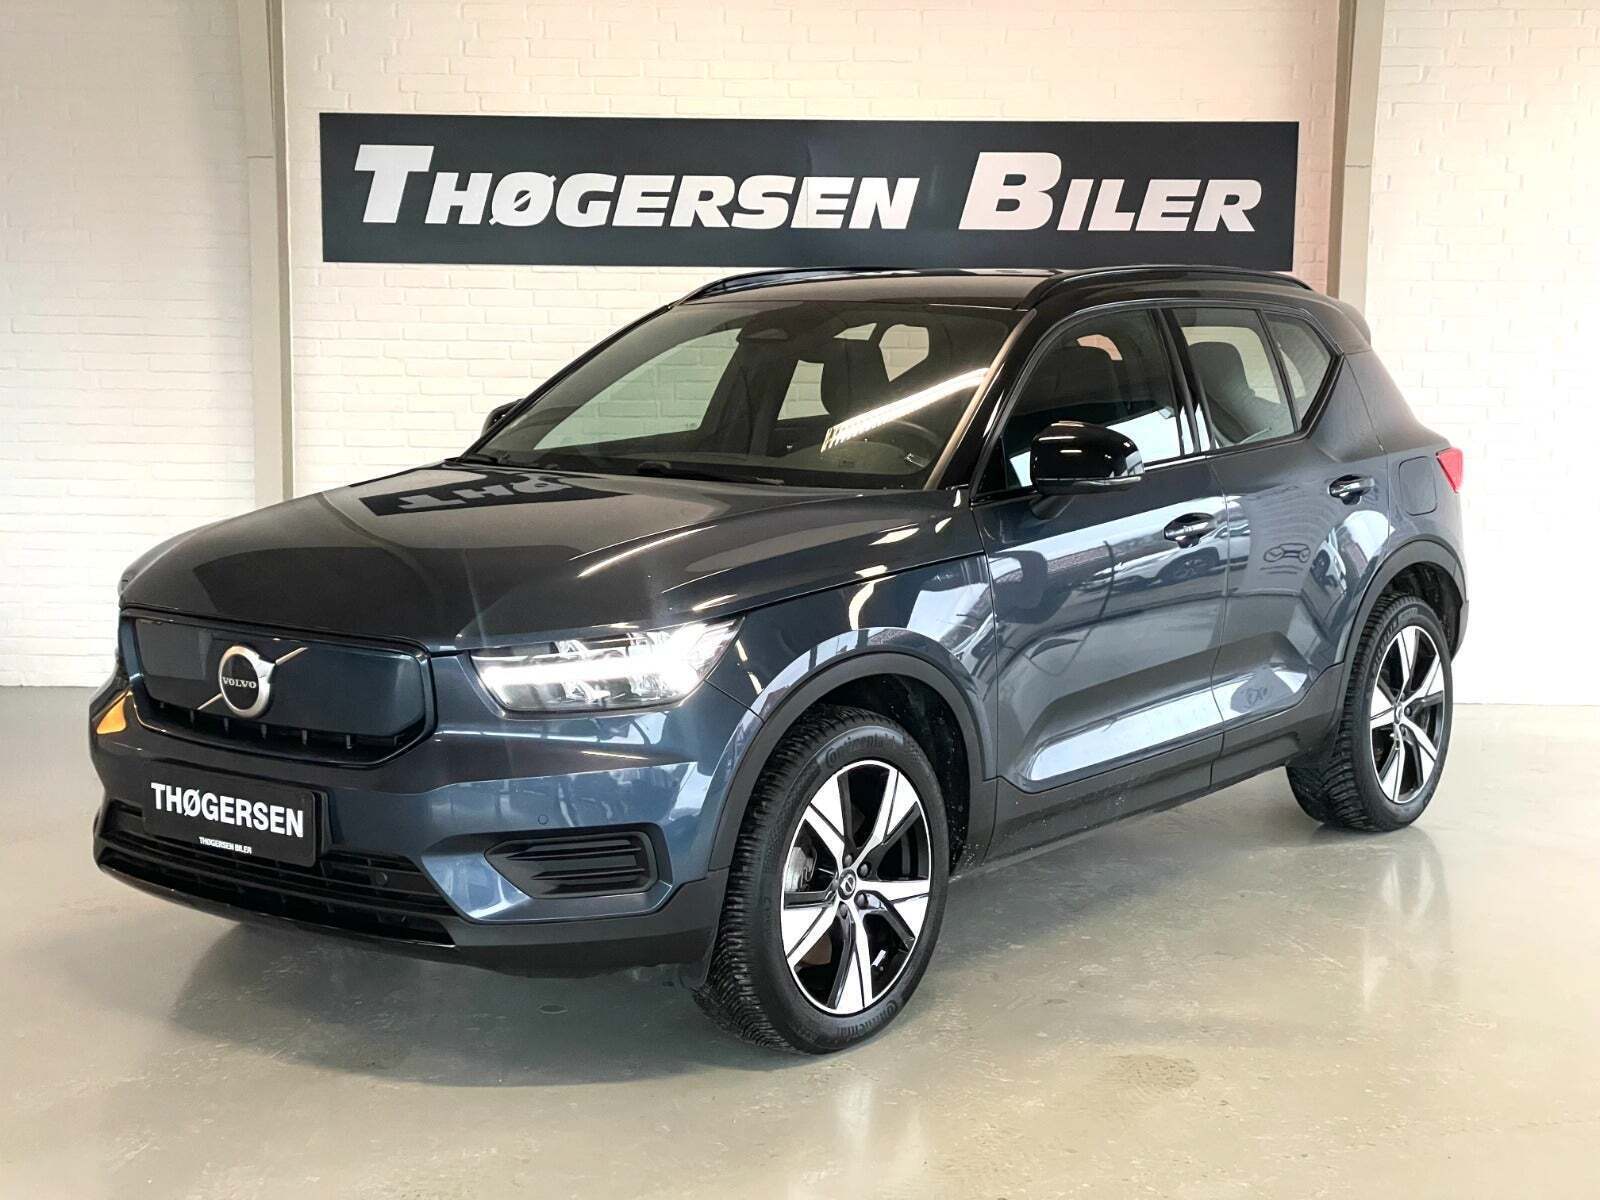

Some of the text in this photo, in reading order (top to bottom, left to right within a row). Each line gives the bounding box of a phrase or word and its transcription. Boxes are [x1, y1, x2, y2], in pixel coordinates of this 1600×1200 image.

[354, 144, 1263, 232] THØGERSEN BILER
[222, 676, 257, 689] VOLVO
[151, 782, 304, 838] THØGERSEN
